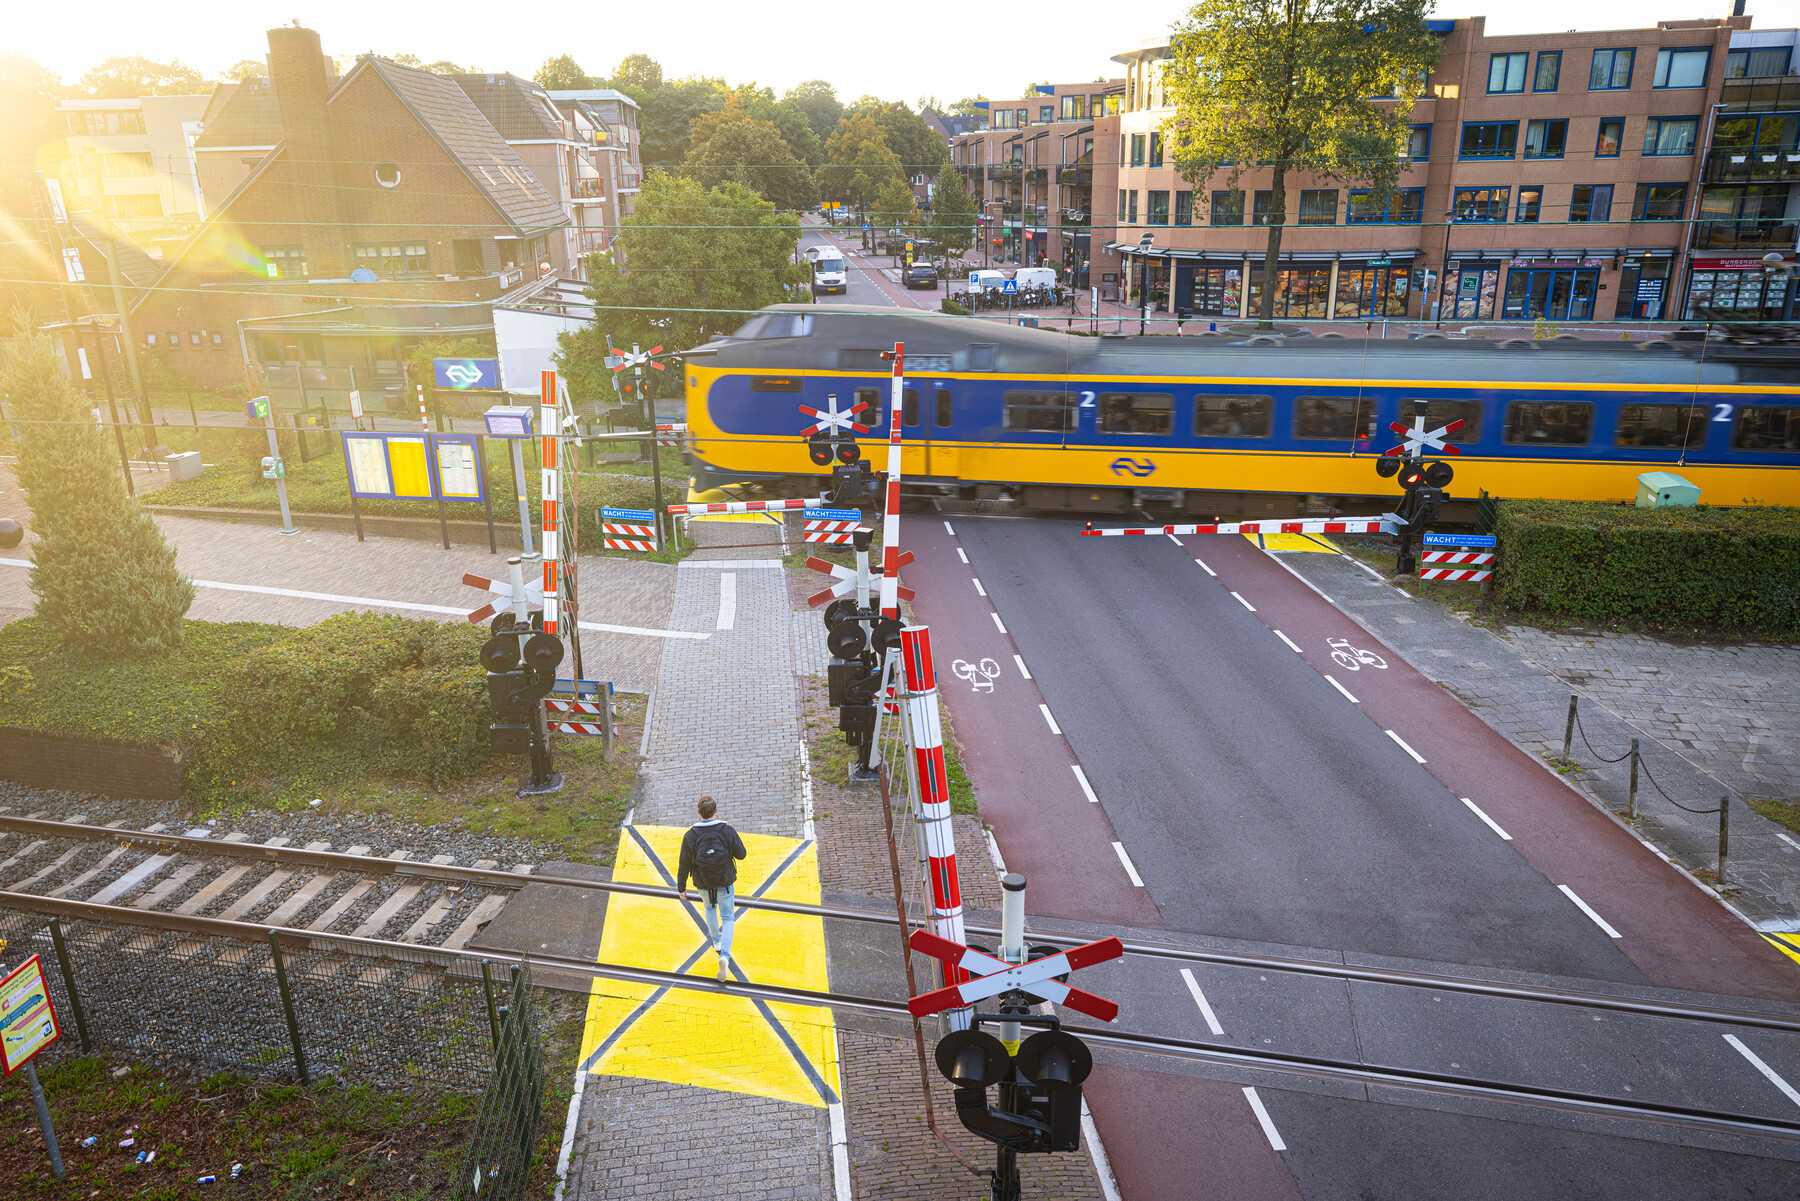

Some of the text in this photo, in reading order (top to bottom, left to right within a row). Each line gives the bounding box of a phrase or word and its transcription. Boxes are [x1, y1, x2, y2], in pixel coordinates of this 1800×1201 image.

[1080, 391, 1096, 408] 2
[1712, 404, 1733, 422] 2
[1426, 536, 1456, 544] WACHT
